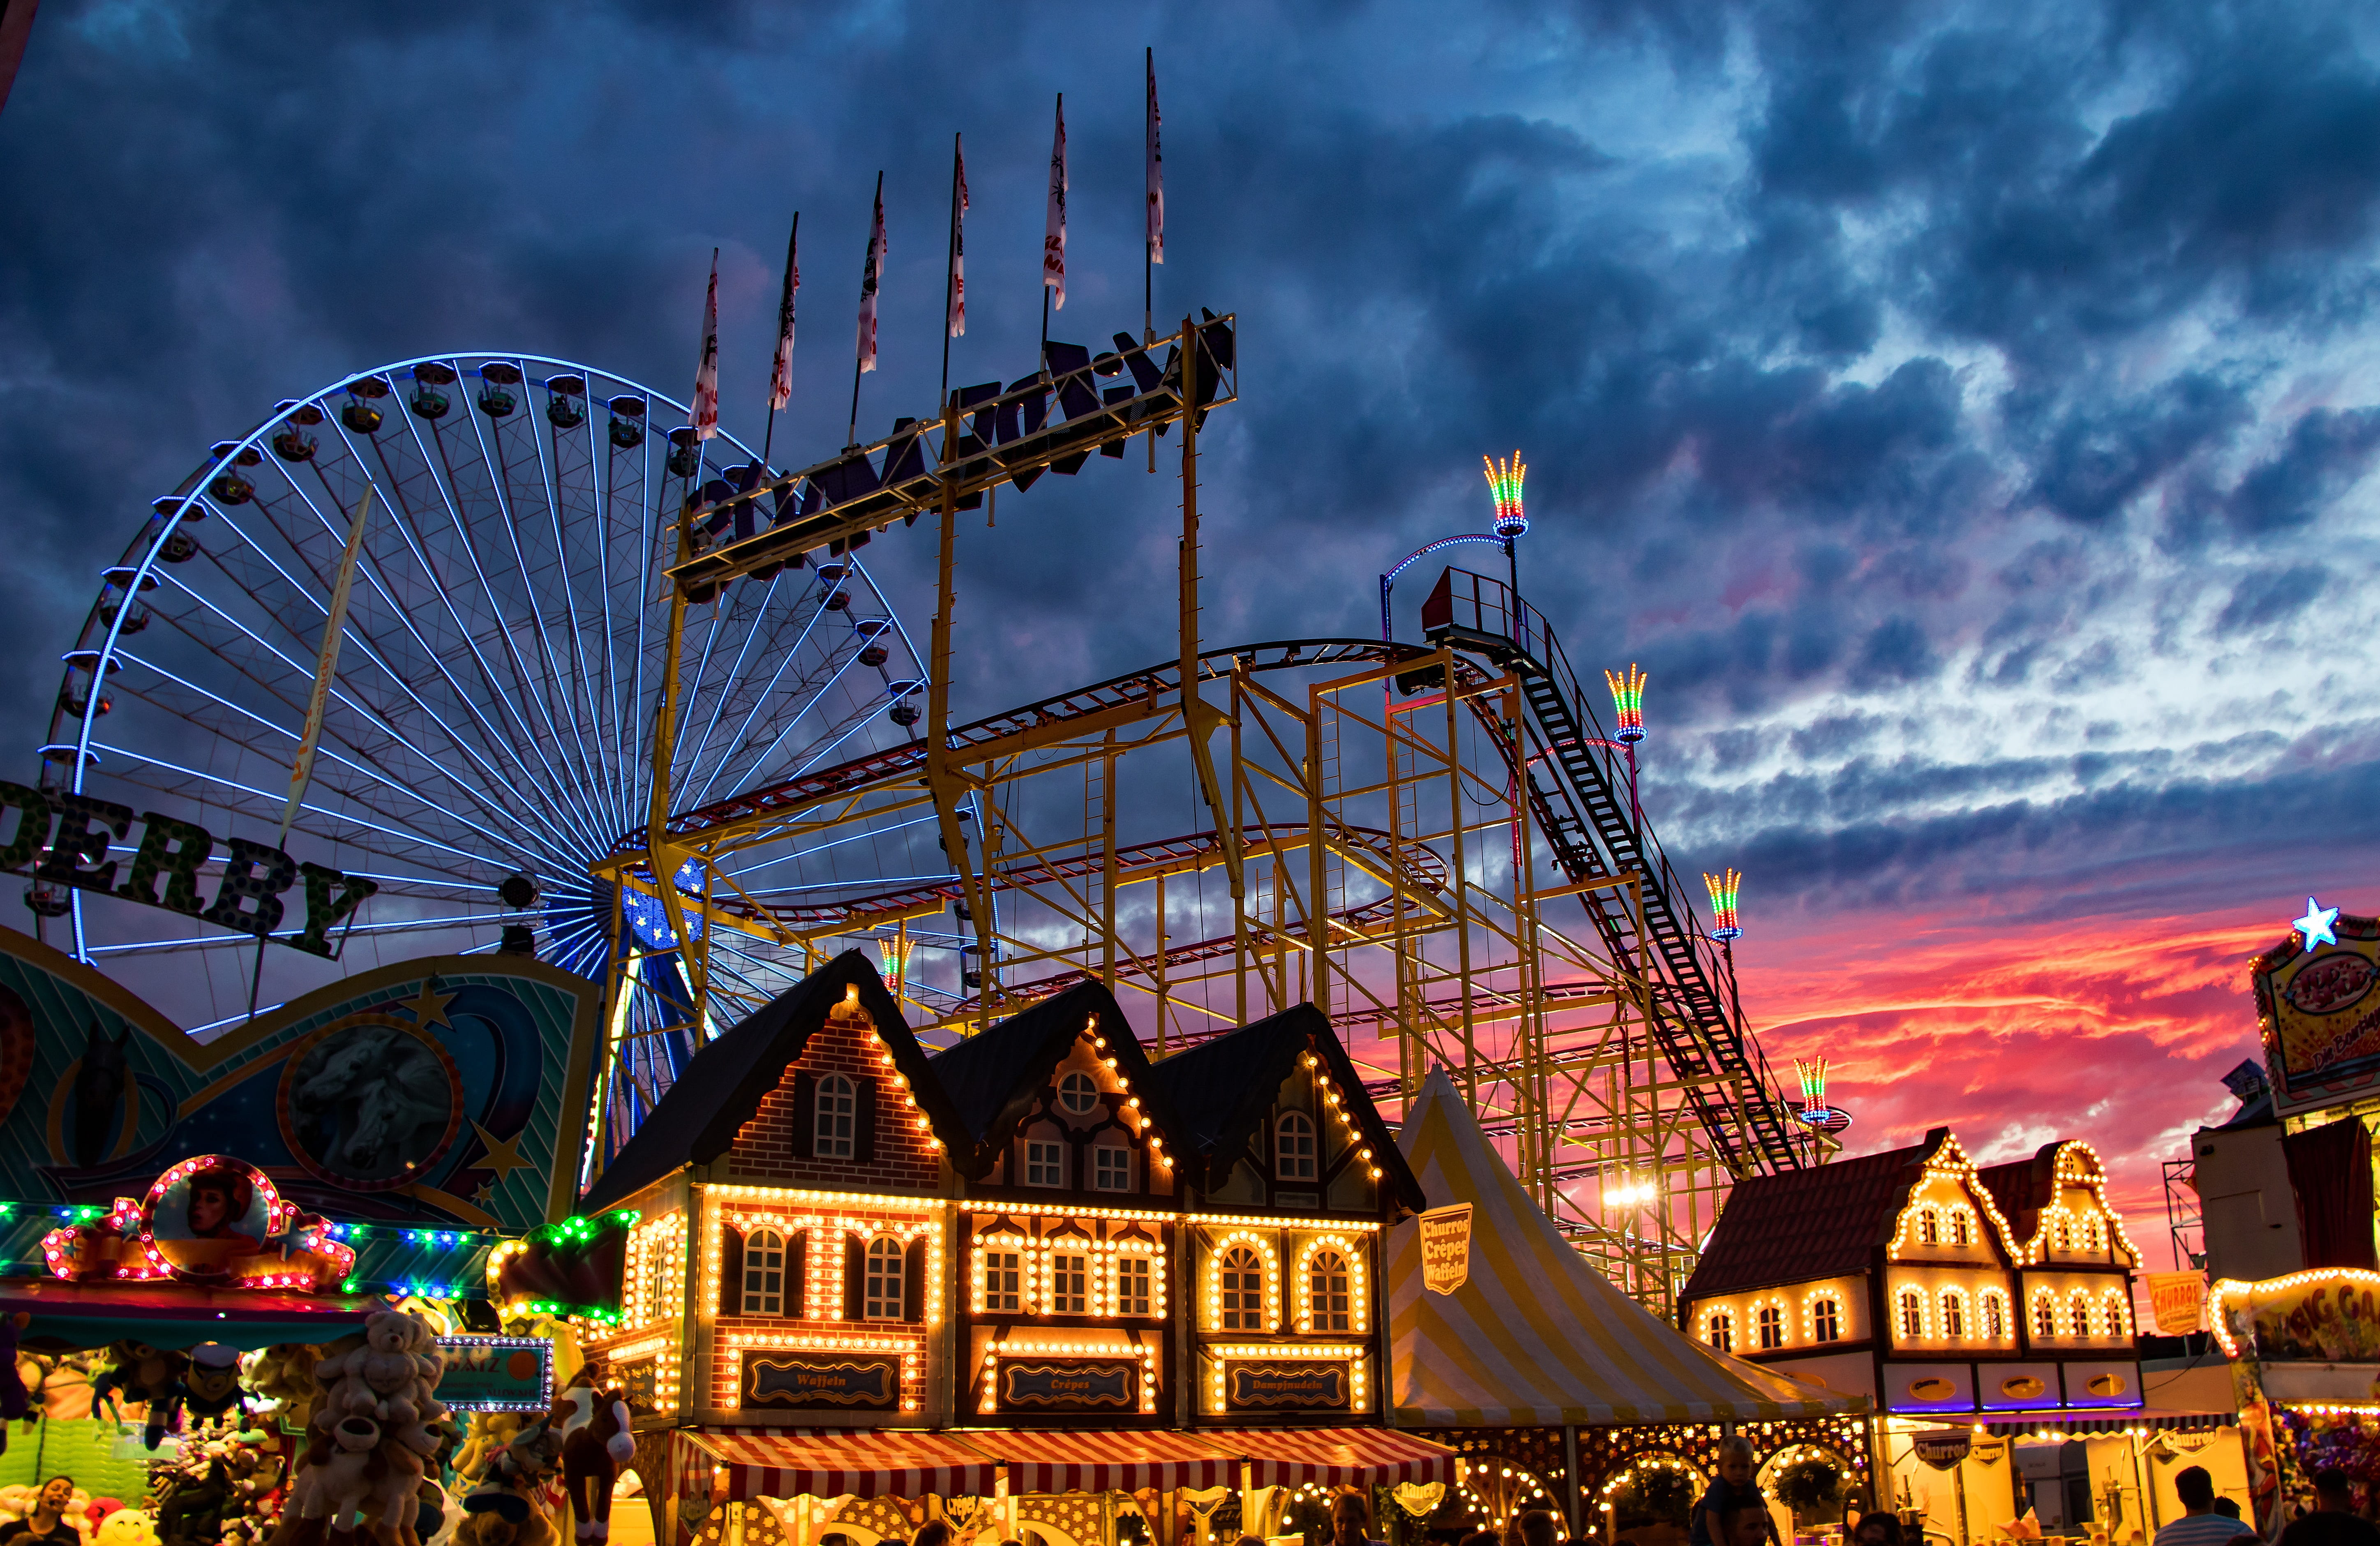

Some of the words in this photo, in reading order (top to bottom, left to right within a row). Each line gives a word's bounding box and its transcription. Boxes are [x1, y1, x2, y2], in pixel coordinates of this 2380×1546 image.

[2301, 967, 2340, 993] TOP
[2313, 971, 2367, 1008] SHOP
[1423, 1219, 1468, 1238] Churros
[1424, 1239, 1467, 1261] Crêpes
[1425, 1260, 1465, 1281] Waffeln
[2154, 1284, 2198, 1315] CHURROS
[2290, 1288, 2334, 1339] BIG
[2338, 1285, 2380, 1324] GA
[797, 1375, 846, 1387] Waffeln
[1253, 1380, 1323, 1391] Dampfnudeln
[2166, 1431, 2215, 1447] Churros
[1917, 1442, 1967, 1459] Churros
[1972, 1446, 2003, 1460] Churros
